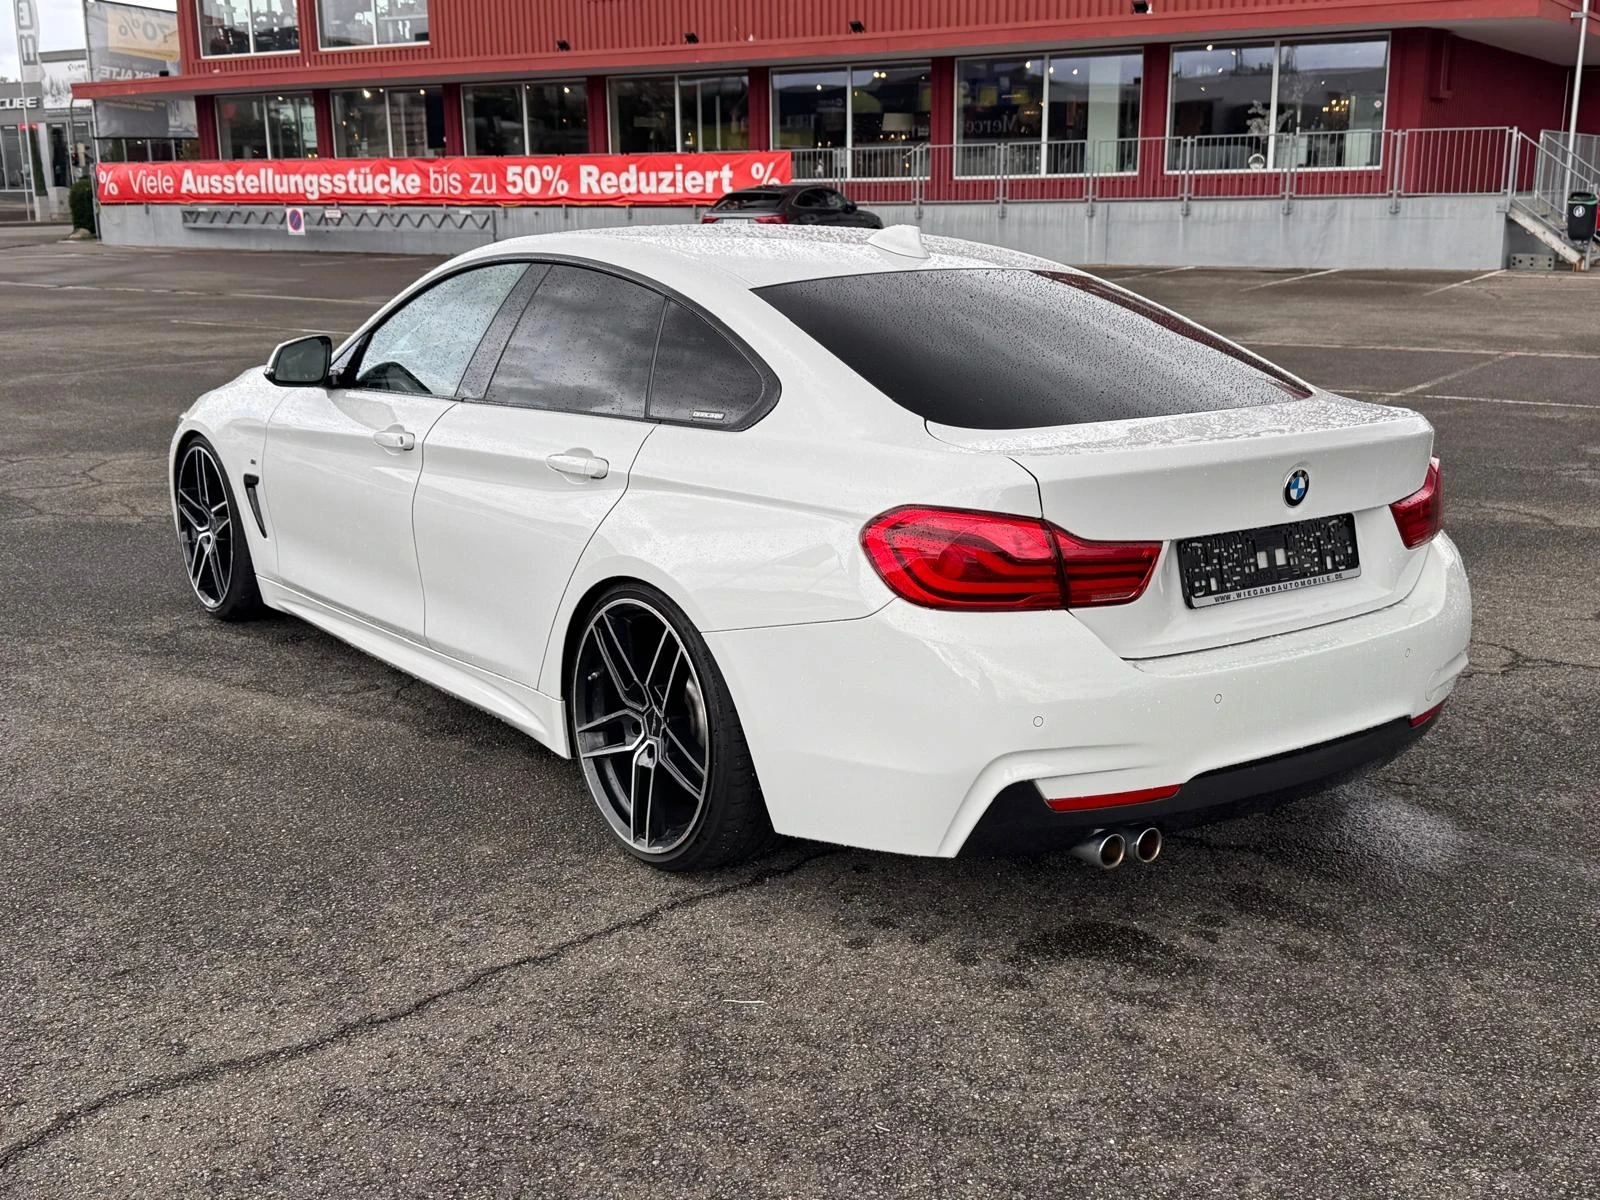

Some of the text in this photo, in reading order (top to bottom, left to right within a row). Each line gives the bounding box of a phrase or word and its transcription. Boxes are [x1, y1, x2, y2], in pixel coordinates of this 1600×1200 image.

[99, 170, 119, 196] %
[128, 169, 174, 194] Viele
[181, 167, 421, 200] Ausstellungsstücke
[430, 167, 463, 195] bis
[470, 173, 497, 195] zu
[506, 165, 570, 196] 50%
[580, 163, 734, 195] Reduziert
